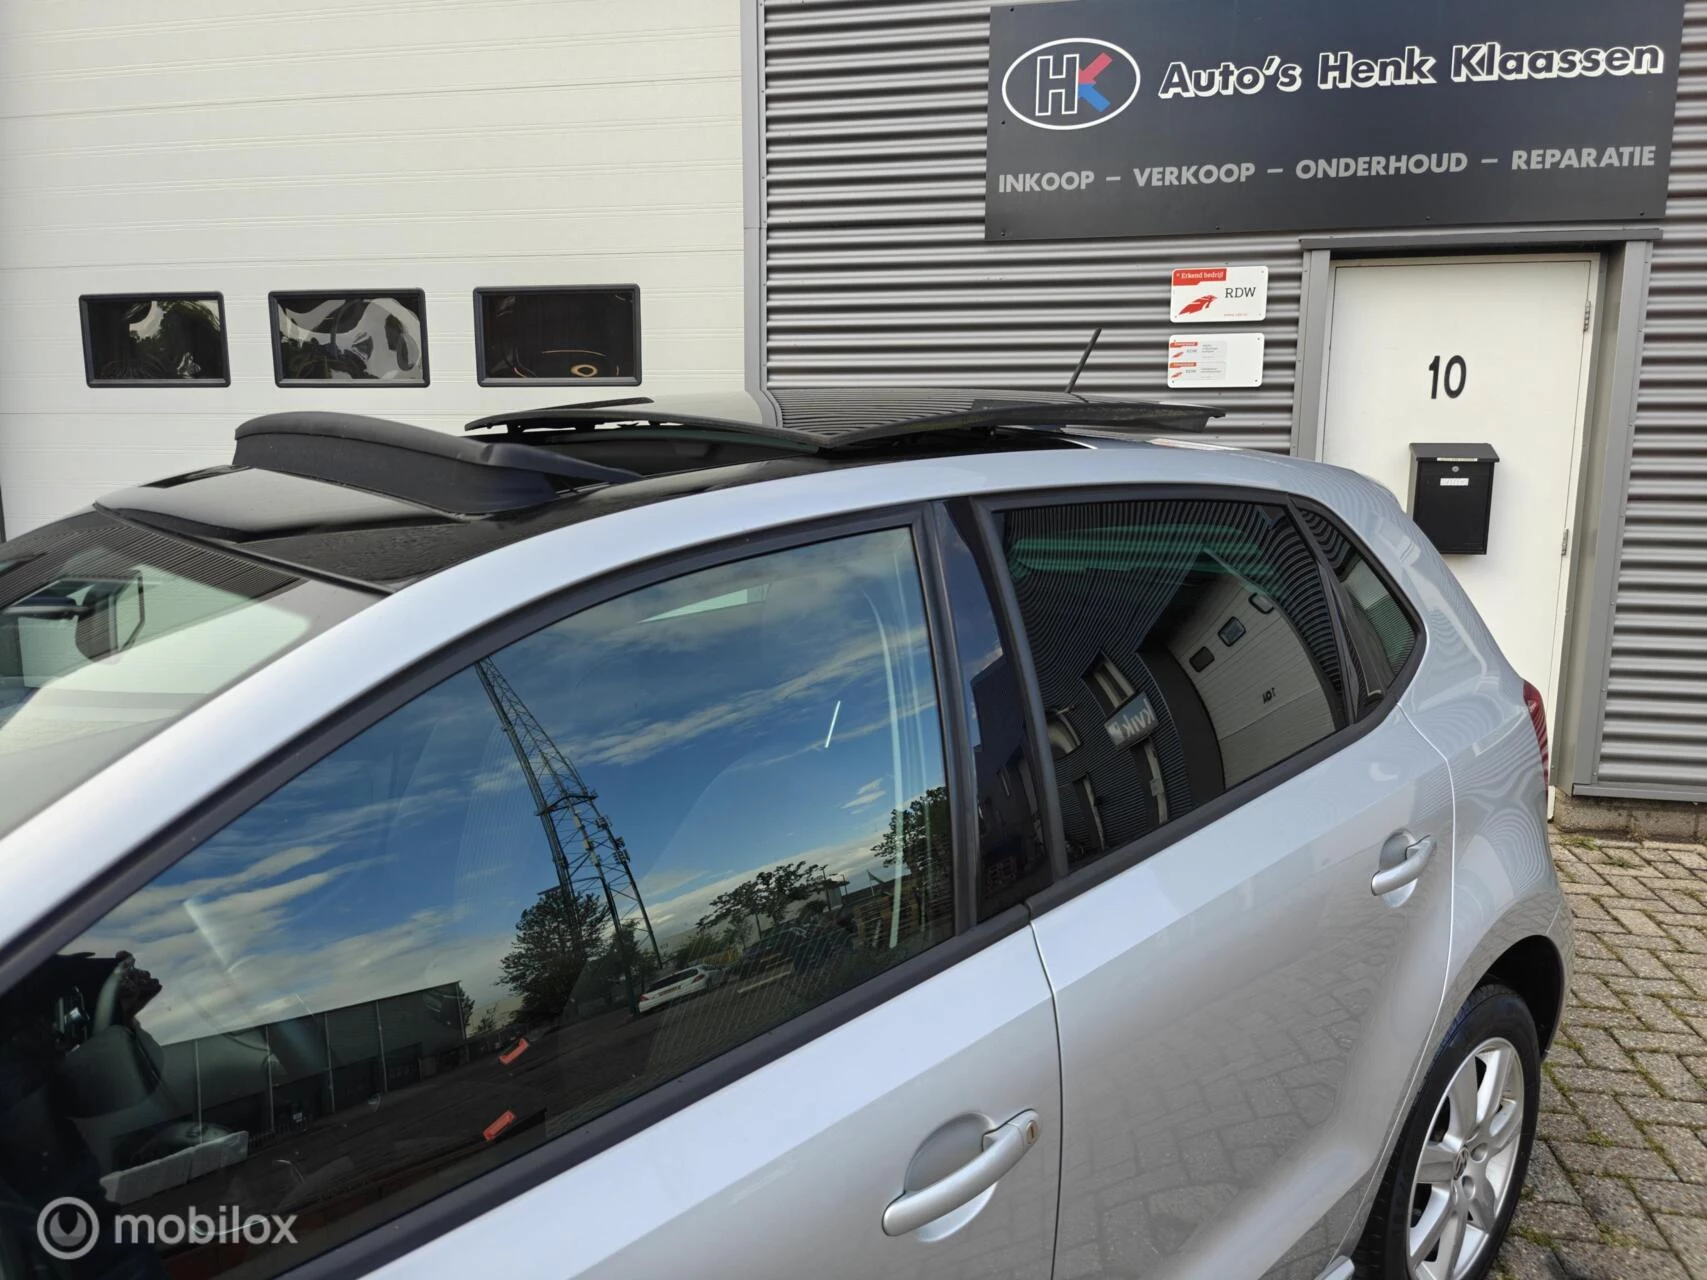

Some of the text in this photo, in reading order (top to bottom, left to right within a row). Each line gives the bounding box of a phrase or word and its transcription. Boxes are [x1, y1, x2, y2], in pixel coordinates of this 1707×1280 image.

[1158, 42, 1664, 99] Auto's Henk Klaassen
[998, 171, 1095, 193] INKOOP
[1133, 163, 1255, 187] VERKOOP
[1295, 152, 1468, 179] ONDERHOUD
[1511, 146, 1656, 170] REPARATIE
[1225, 287, 1256, 299] RDW
[1428, 355, 1467, 399] 10
